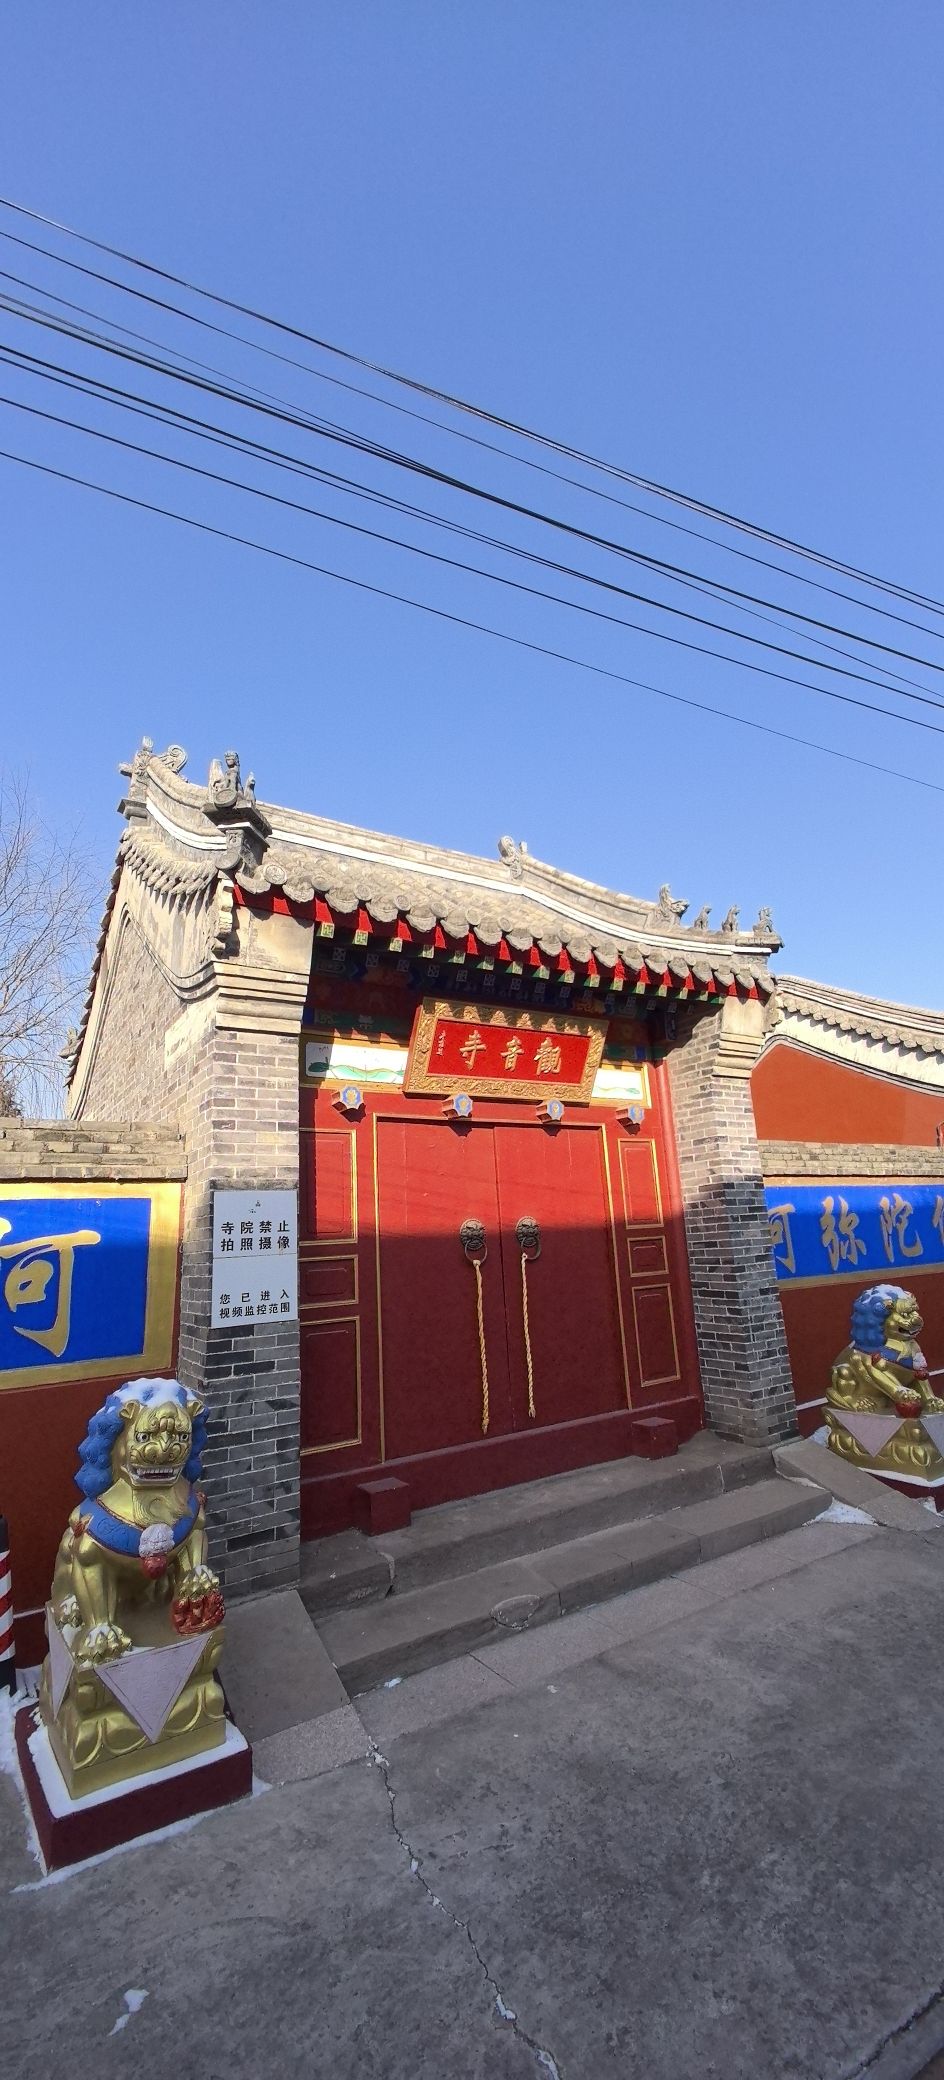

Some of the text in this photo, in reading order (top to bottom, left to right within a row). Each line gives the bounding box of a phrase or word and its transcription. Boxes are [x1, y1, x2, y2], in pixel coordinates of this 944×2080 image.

[220, 1219, 291, 1235] 寺院禁止
[768, 1192, 944, 1274] 弥陀
[220, 1236, 291, 1252] 拍照摄像
[219, 1288, 290, 1305] 您已进入
[219, 1301, 291, 1320] 视频监控范围
